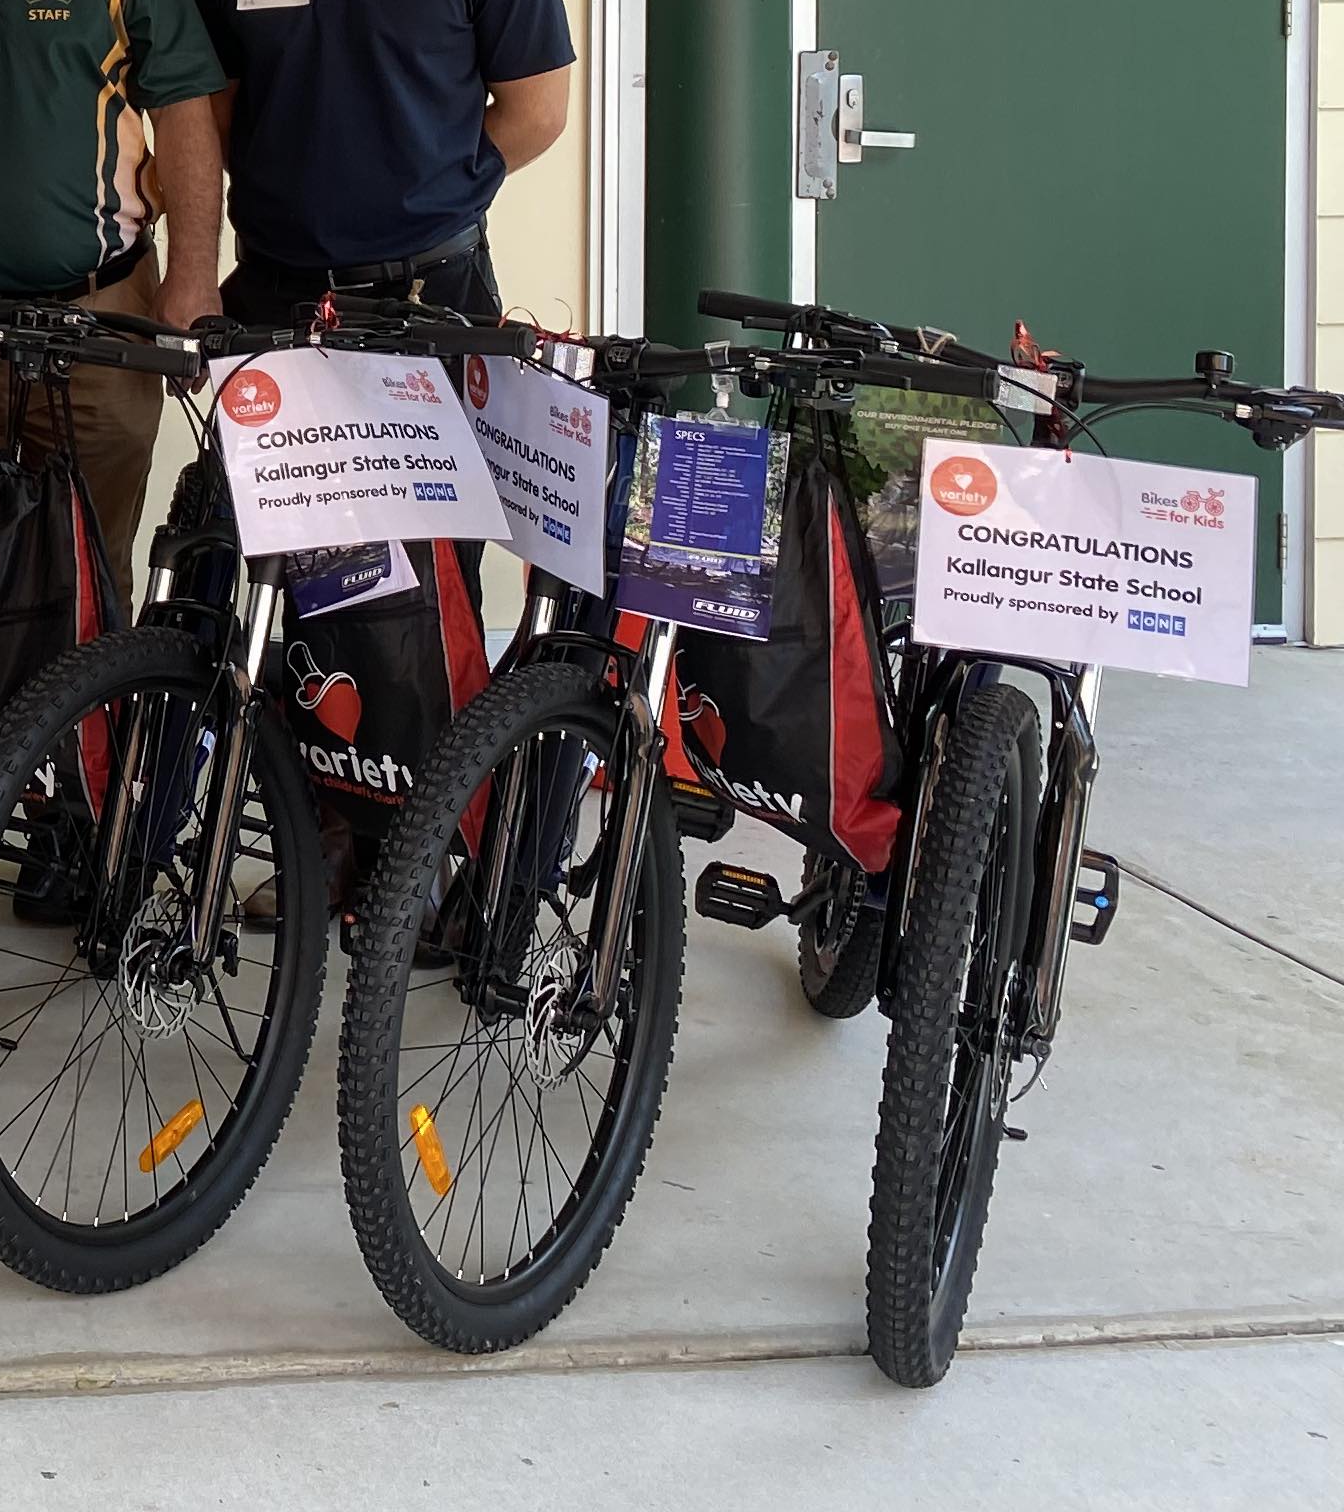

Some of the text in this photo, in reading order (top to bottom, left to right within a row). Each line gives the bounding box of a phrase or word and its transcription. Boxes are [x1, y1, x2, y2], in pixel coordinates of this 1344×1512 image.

[28, 9, 70, 20] STAFF
[382, 376, 405, 390] Bikes
[405, 391, 442, 404] for Kids
[232, 400, 275, 416] variety
[550, 406, 569, 423] Bikes
[857, 411, 996, 430] OUR ENVIRONMENTAL PLEDGE
[257, 423, 439, 450] CONGRATULATIONS
[675, 430, 705, 442] SPECS
[922, 426, 948, 435] PLANT
[950, 429, 968, 437] ONE
[476, 417, 575, 482] CONGRATULATIONS
[255, 454, 457, 483] Kallangur State School
[259, 483, 457, 509] Proudly sponsored by KONE
[513, 471, 579, 517] State School
[940, 489, 988, 505] variety
[1141, 492, 1178, 509] Bikes
[529, 507, 539, 525] by
[543, 514, 571, 545] KONE
[1169, 510, 1224, 529] for Kids
[958, 524, 1193, 568] CONGRATULATIONS
[344, 566, 384, 586] FLUID
[947, 556, 1202, 605] Kallangur State School
[694, 601, 757, 619] FLUID
[944, 588, 1185, 636] Proudly sponsored by KONE
